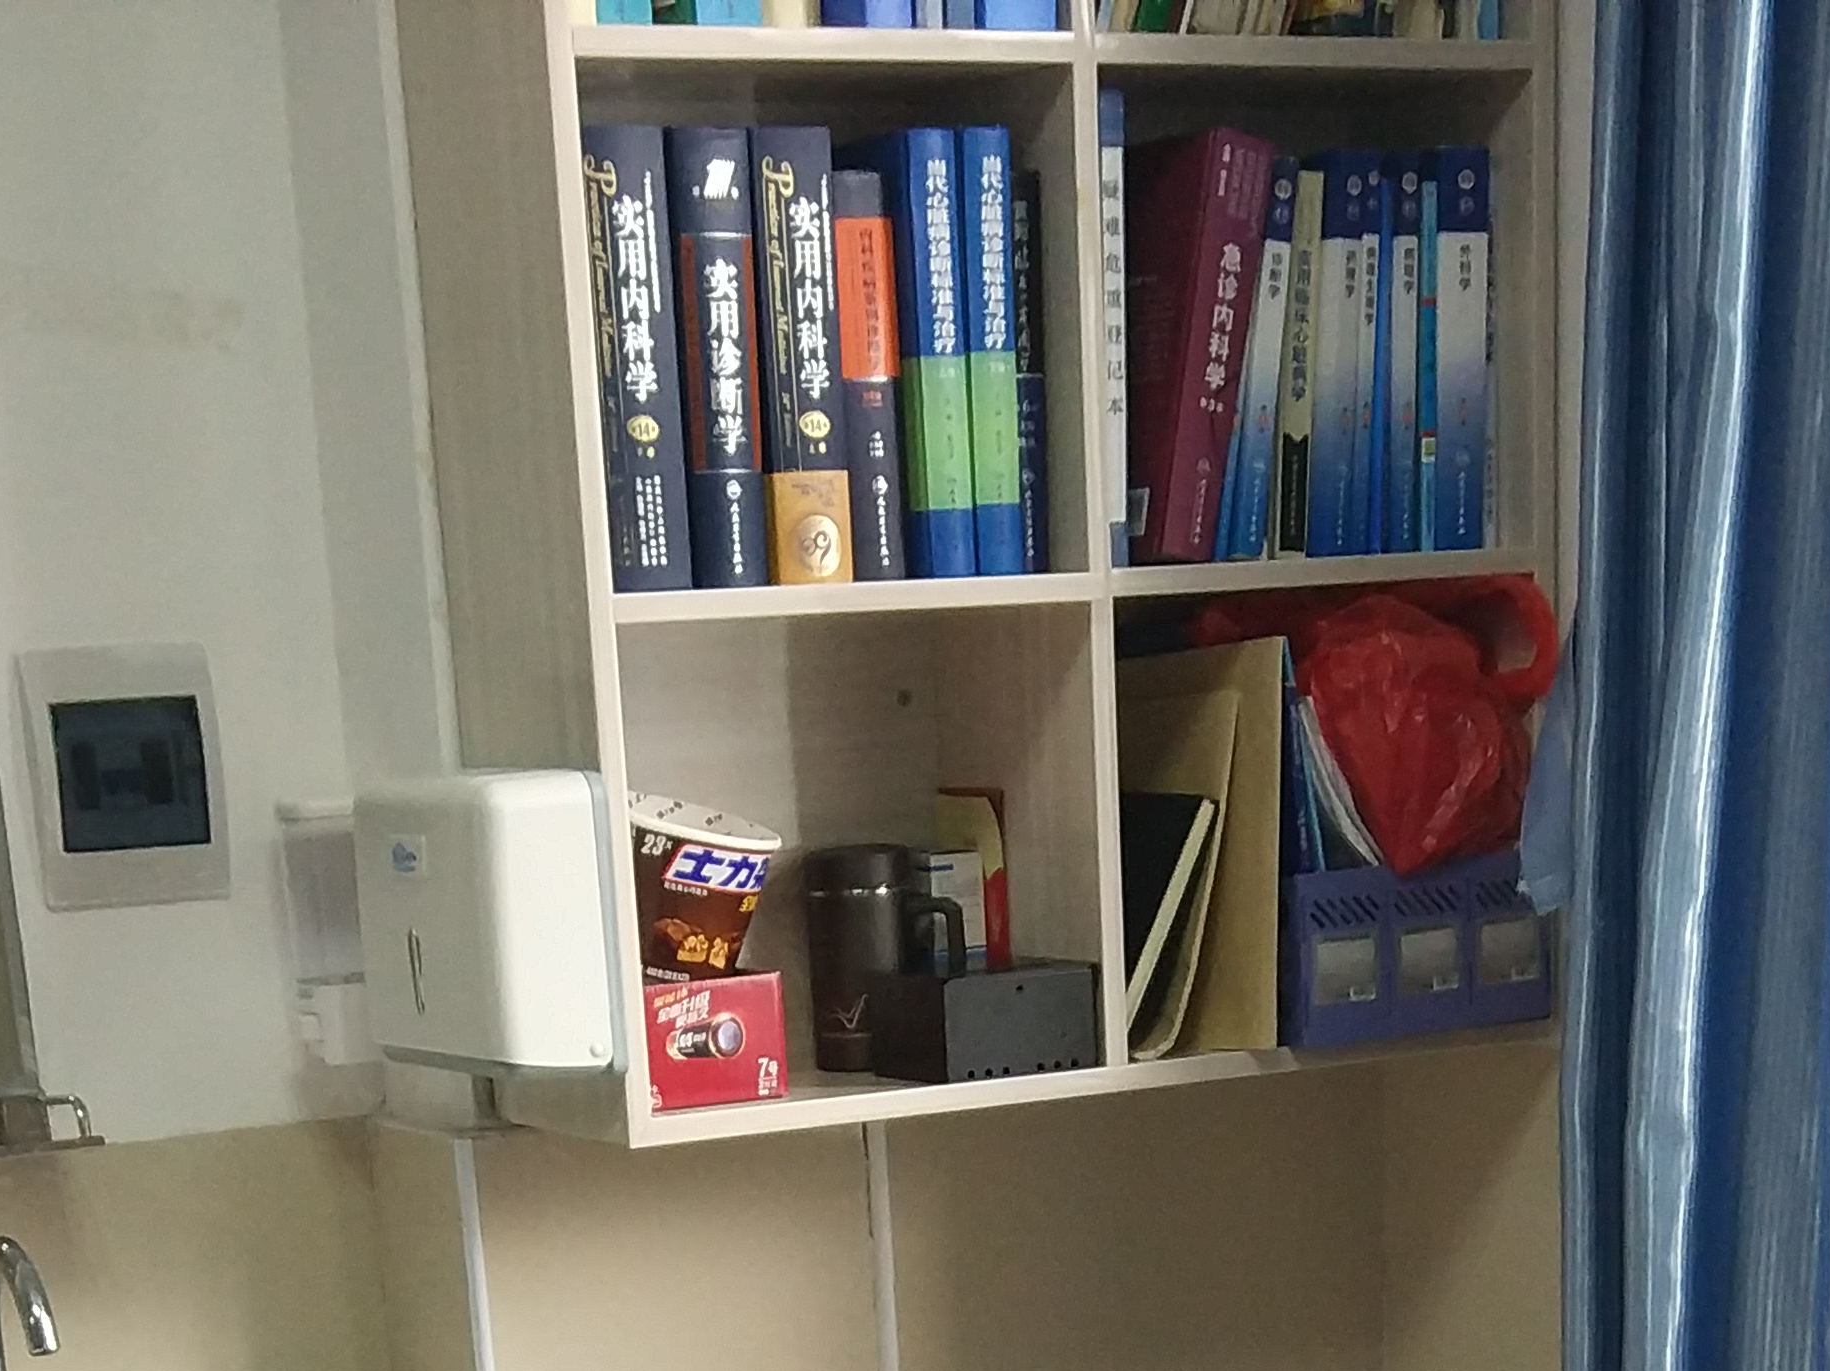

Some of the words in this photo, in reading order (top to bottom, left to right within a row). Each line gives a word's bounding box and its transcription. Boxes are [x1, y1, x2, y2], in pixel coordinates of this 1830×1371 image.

[612, 195, 658, 402] 实用内科学
[704, 258, 747, 456] 实用诊断学
[789, 196, 831, 399] 实用内科学
[1204, 242, 1241, 392] 急诊内科学
